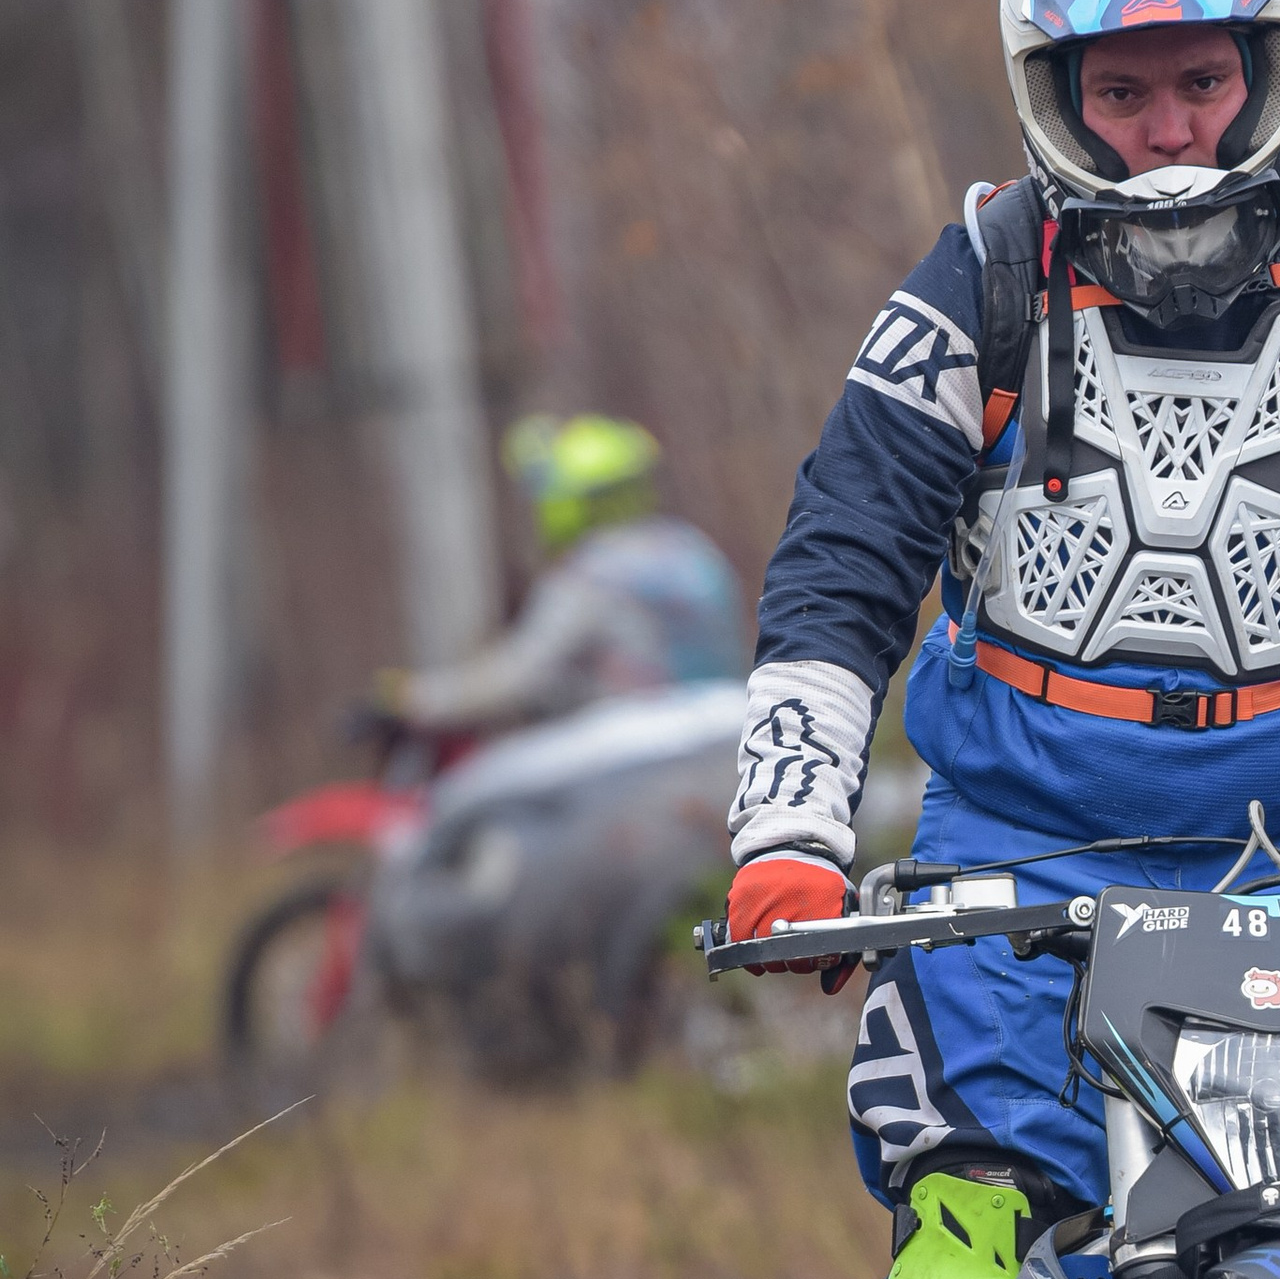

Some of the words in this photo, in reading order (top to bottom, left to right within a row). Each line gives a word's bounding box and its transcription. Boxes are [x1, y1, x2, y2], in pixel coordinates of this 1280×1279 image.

[1145, 908, 1188, 919] HARD
[1143, 918, 1188, 932] GLIDE
[1222, 908, 1268, 937] 48
